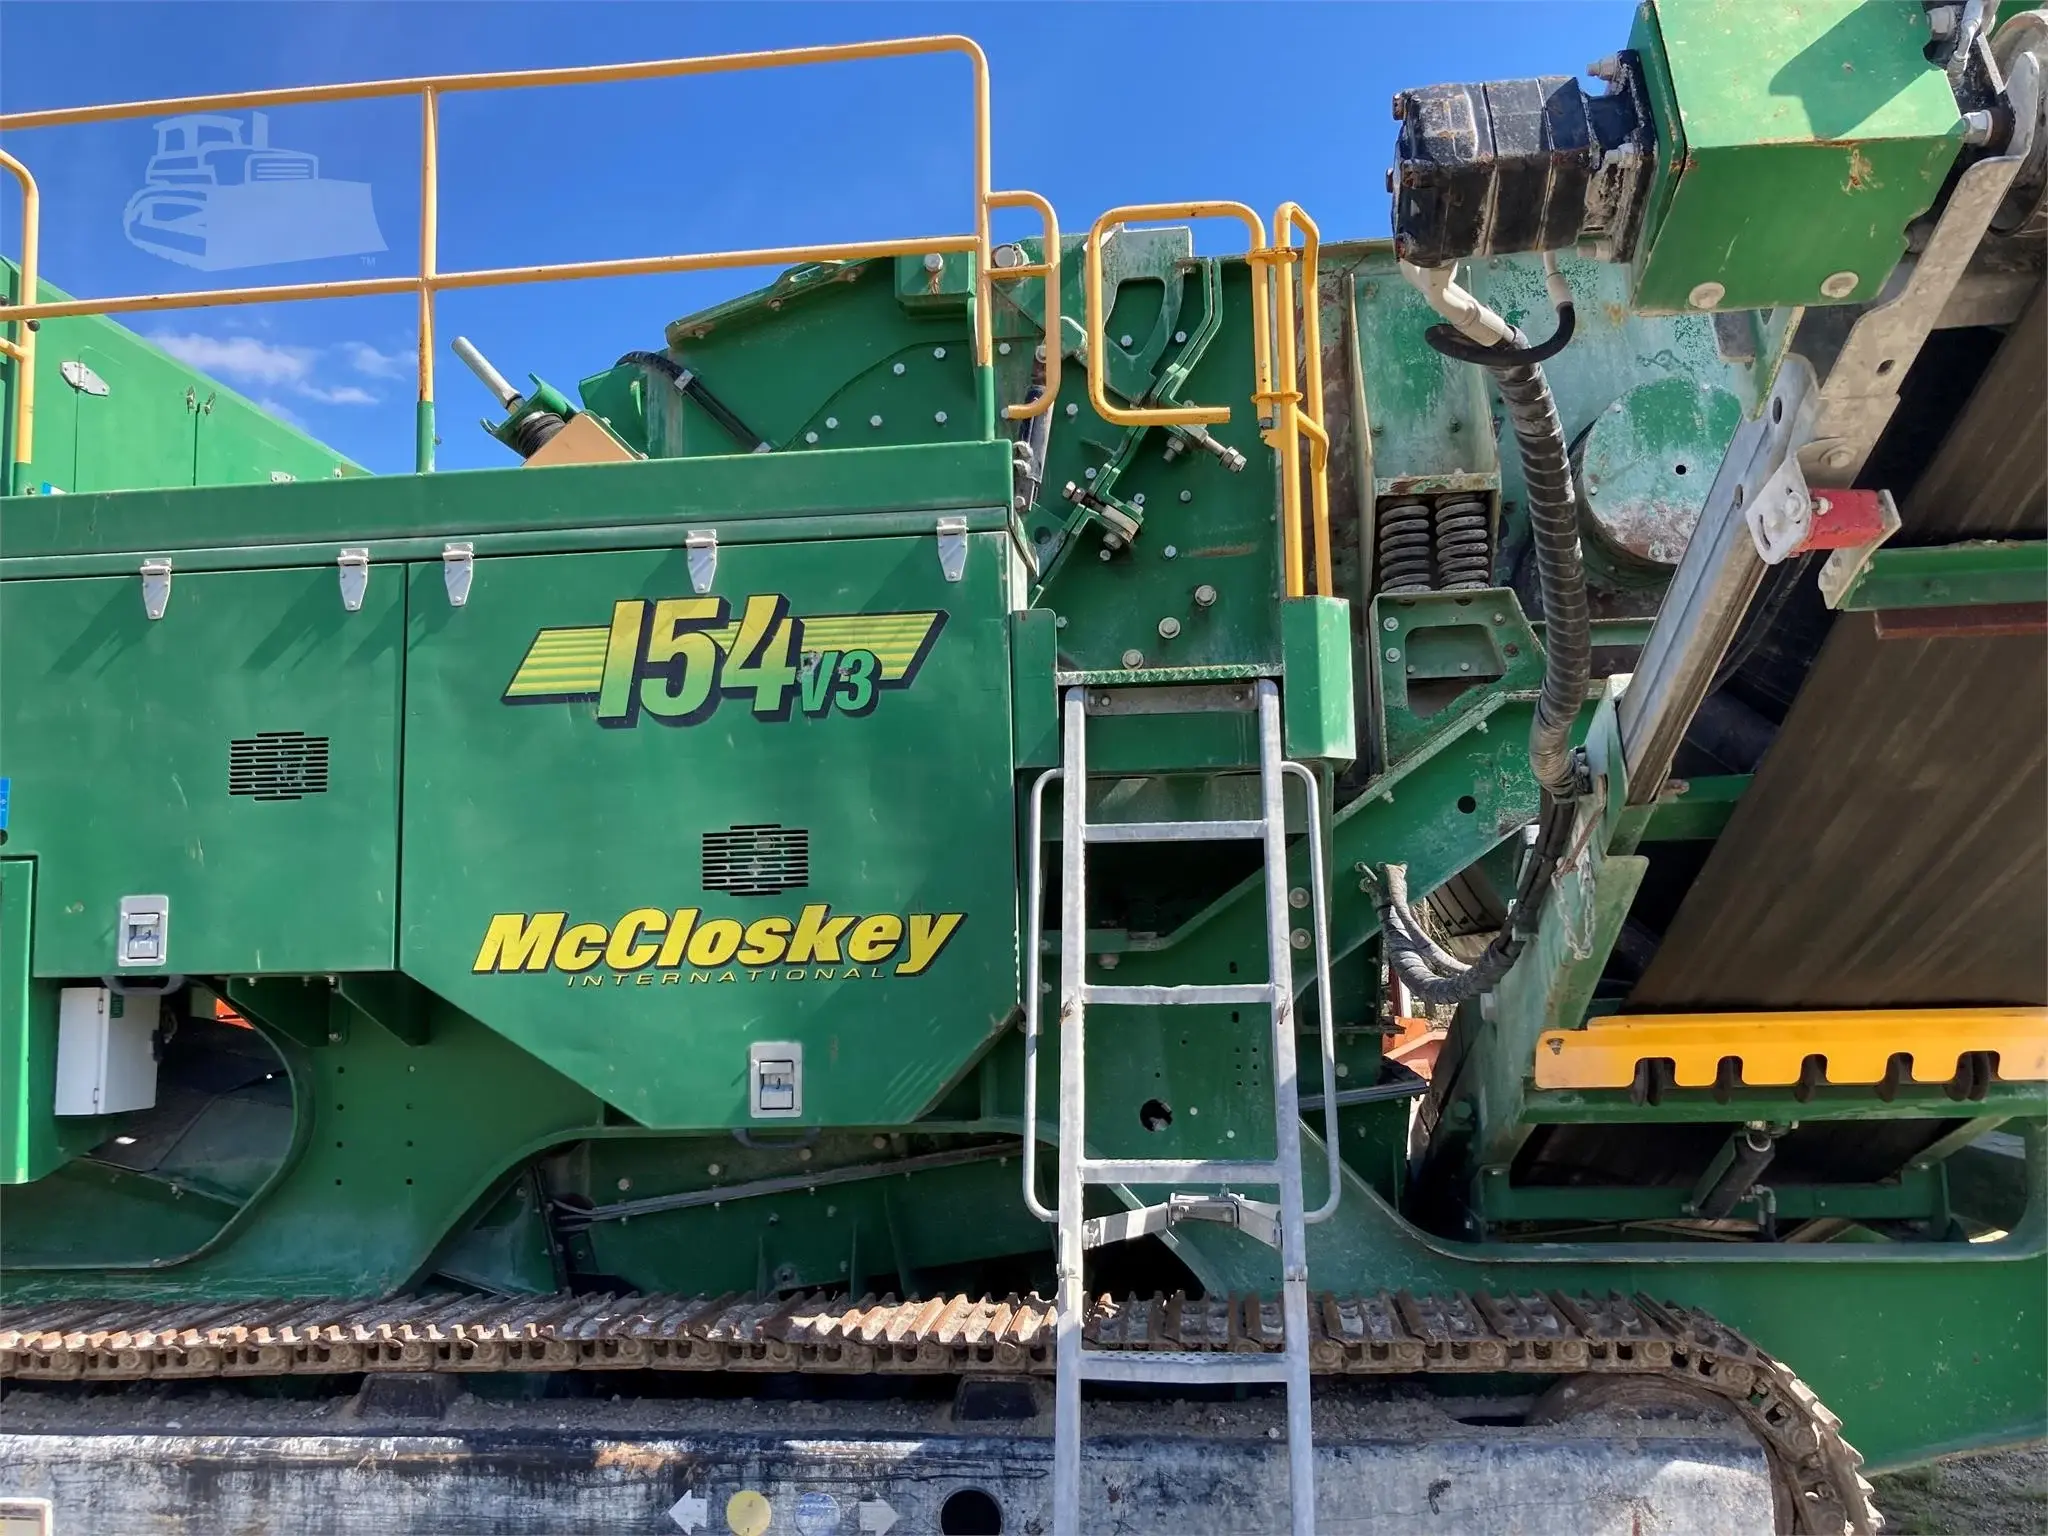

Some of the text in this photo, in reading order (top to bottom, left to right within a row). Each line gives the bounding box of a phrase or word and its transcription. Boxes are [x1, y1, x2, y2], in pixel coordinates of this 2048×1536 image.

[598, 594, 797, 725] 154
[472, 904, 967, 976] McCloskey
[567, 967, 885, 986] INTERNATIONAL
